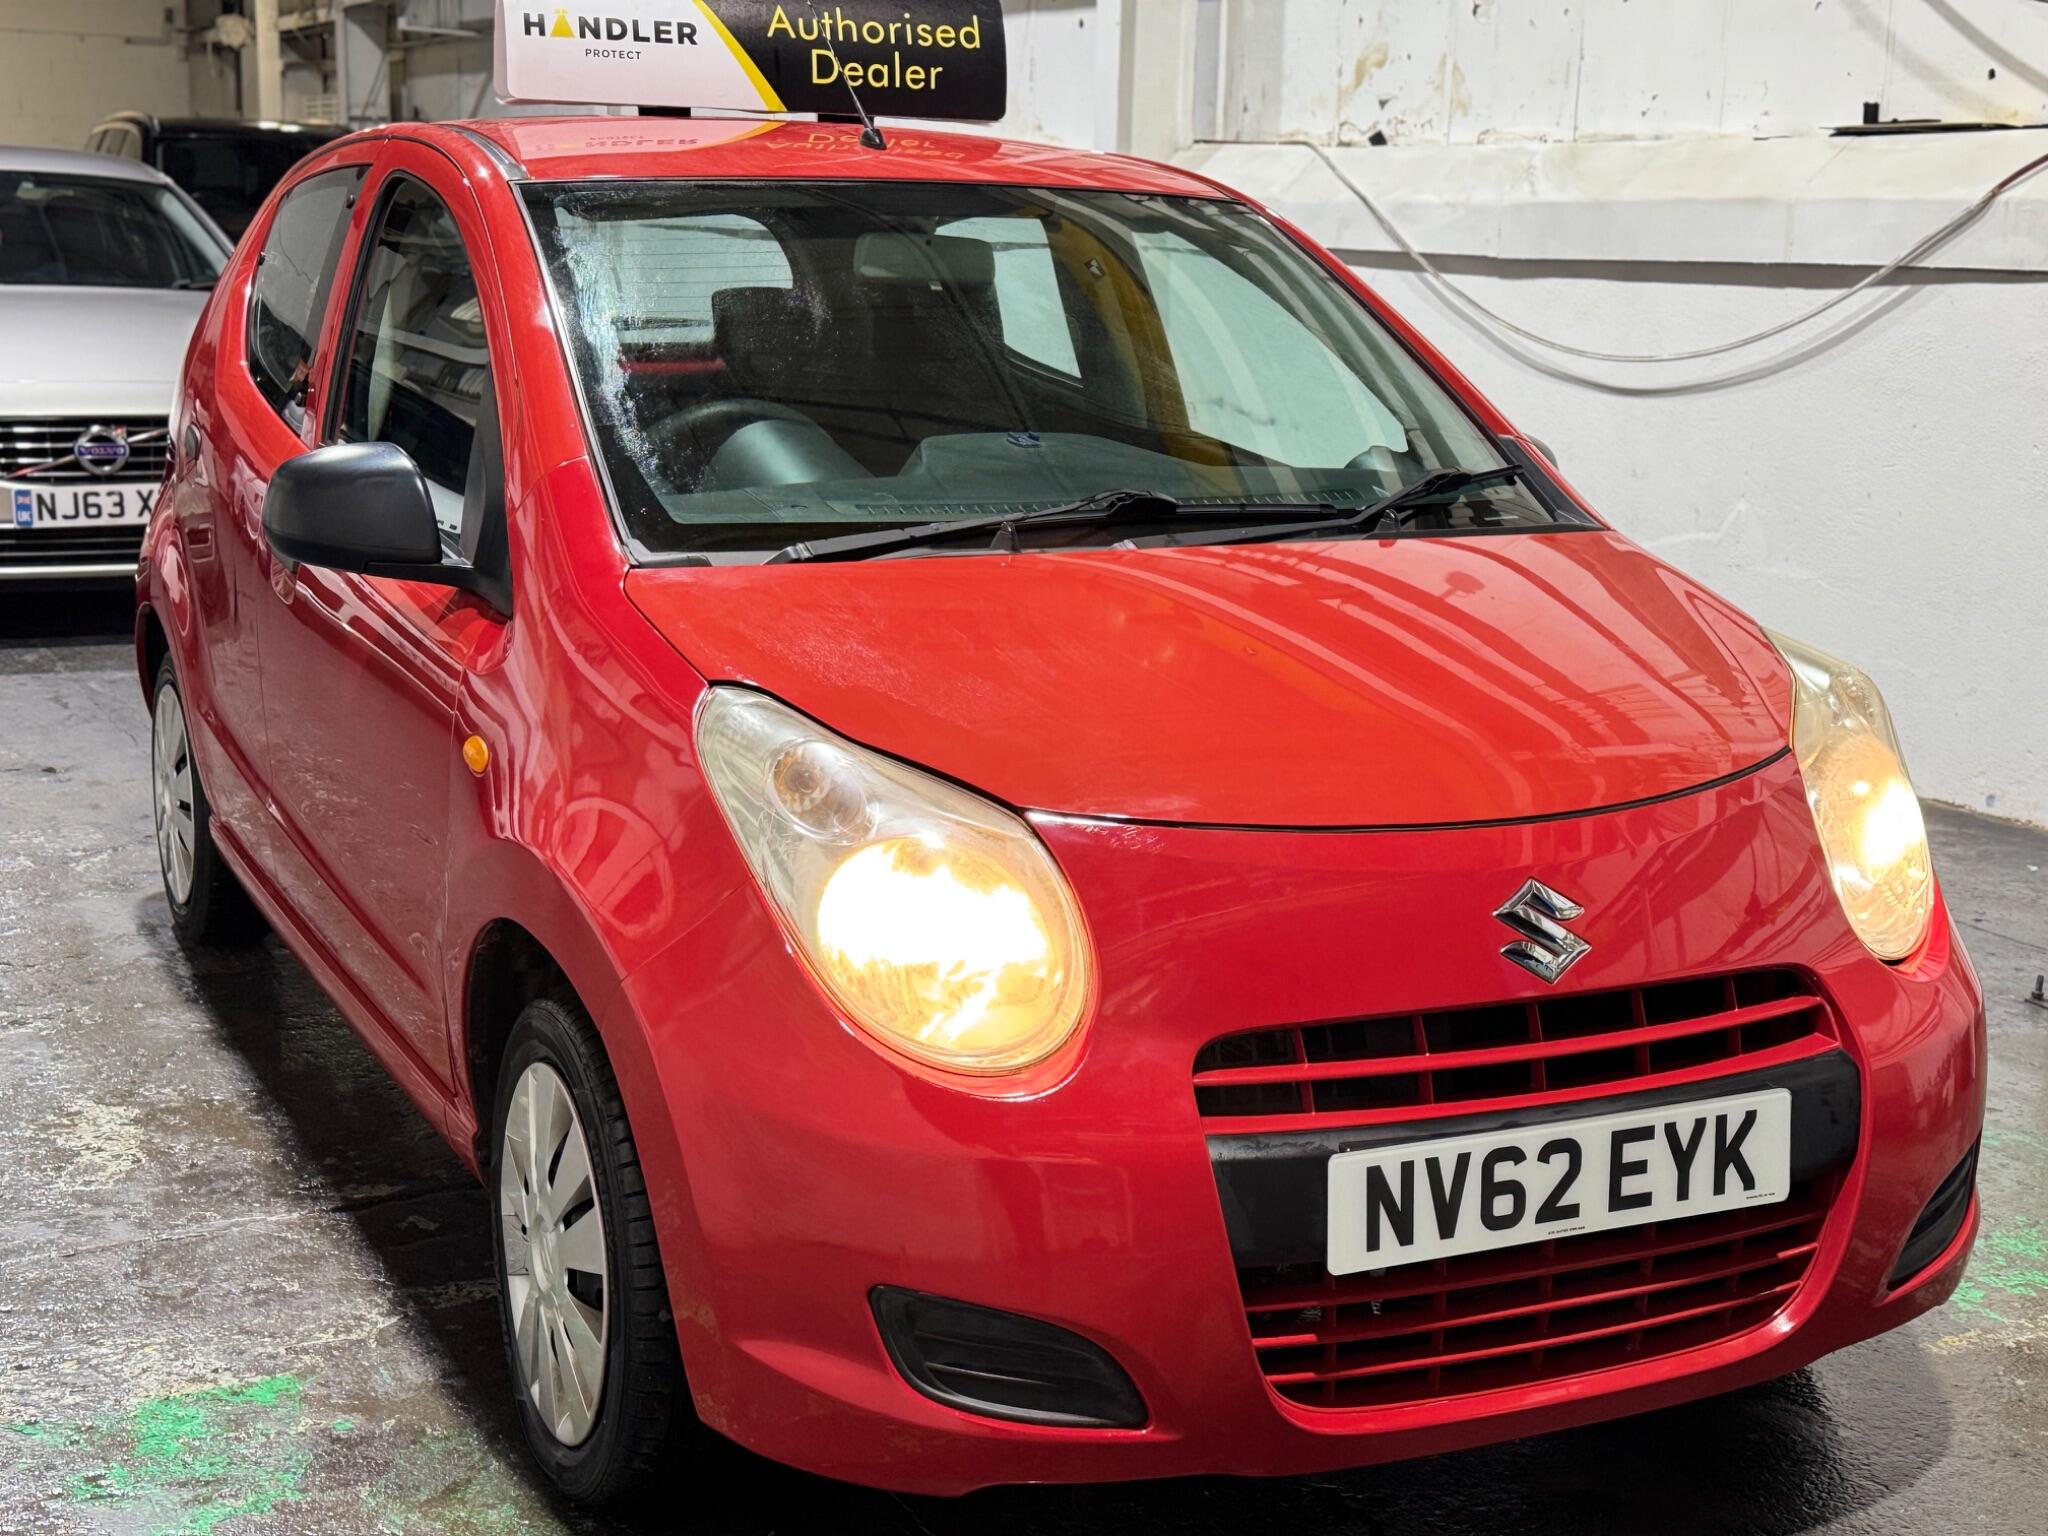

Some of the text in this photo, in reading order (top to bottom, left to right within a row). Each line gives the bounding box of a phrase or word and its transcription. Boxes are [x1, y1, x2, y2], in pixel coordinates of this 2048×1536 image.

[523, 8, 698, 46] HANDLER
[767, 5, 981, 49] Authorised
[585, 48, 641, 60] PROTECT
[811, 48, 943, 90] Dealer
[80, 446, 125, 456] VOLVO
[17, 510, 31, 522] UK
[36, 490, 125, 520] NJ63
[1366, 1108, 1758, 1253] NV62 EYK
